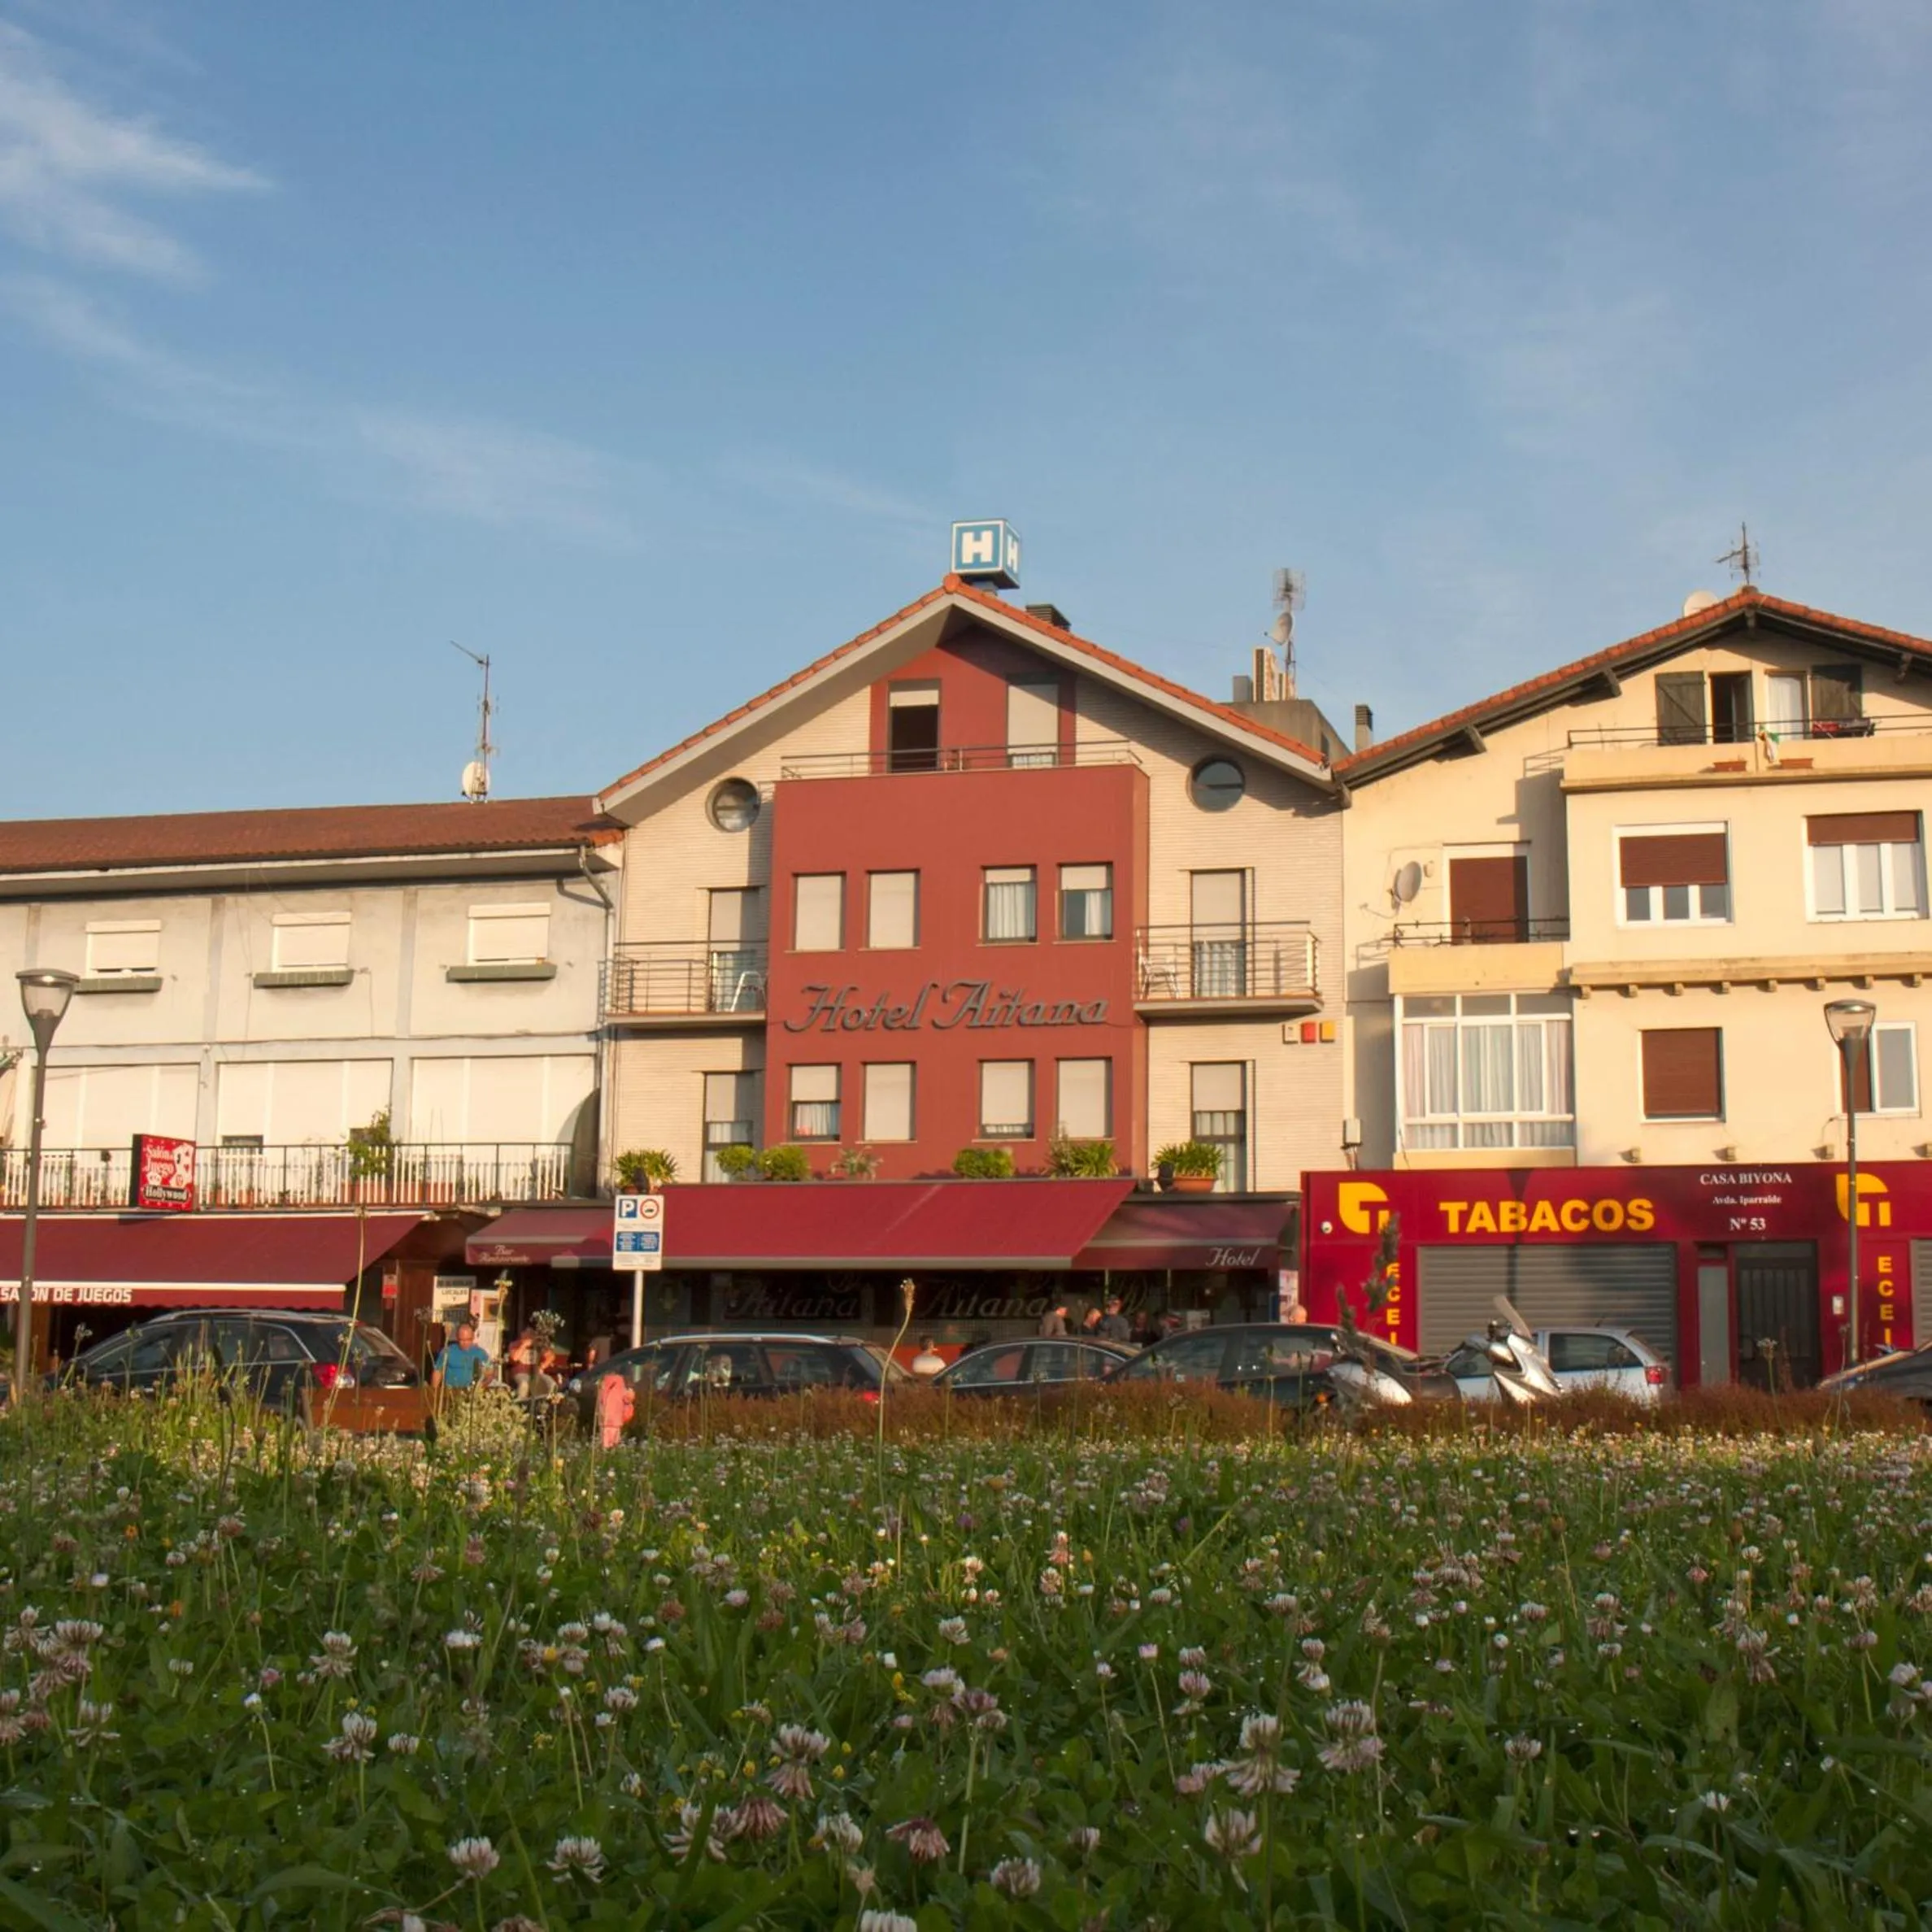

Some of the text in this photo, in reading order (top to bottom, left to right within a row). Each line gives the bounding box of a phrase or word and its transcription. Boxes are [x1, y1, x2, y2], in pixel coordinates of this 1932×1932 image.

[962, 530, 993, 564] H
[1007, 533, 1018, 574] H
[784, 980, 1110, 1032] Hotel Aitana
[144, 1157, 174, 1177] Juego
[1699, 1173, 1736, 1186] CASA
[145, 1186, 188, 1202] Hollywood
[1712, 1195, 1782, 1207] Avda. Iparralde
[621, 1199, 635, 1217] P
[1438, 1198, 1655, 1234] TABACOS
[1749, 1217, 1767, 1231] 53
[1205, 1247, 1263, 1267] Hotel
[53, 1288, 73, 1302] DE
[76, 1288, 133, 1303] JUEGOS
